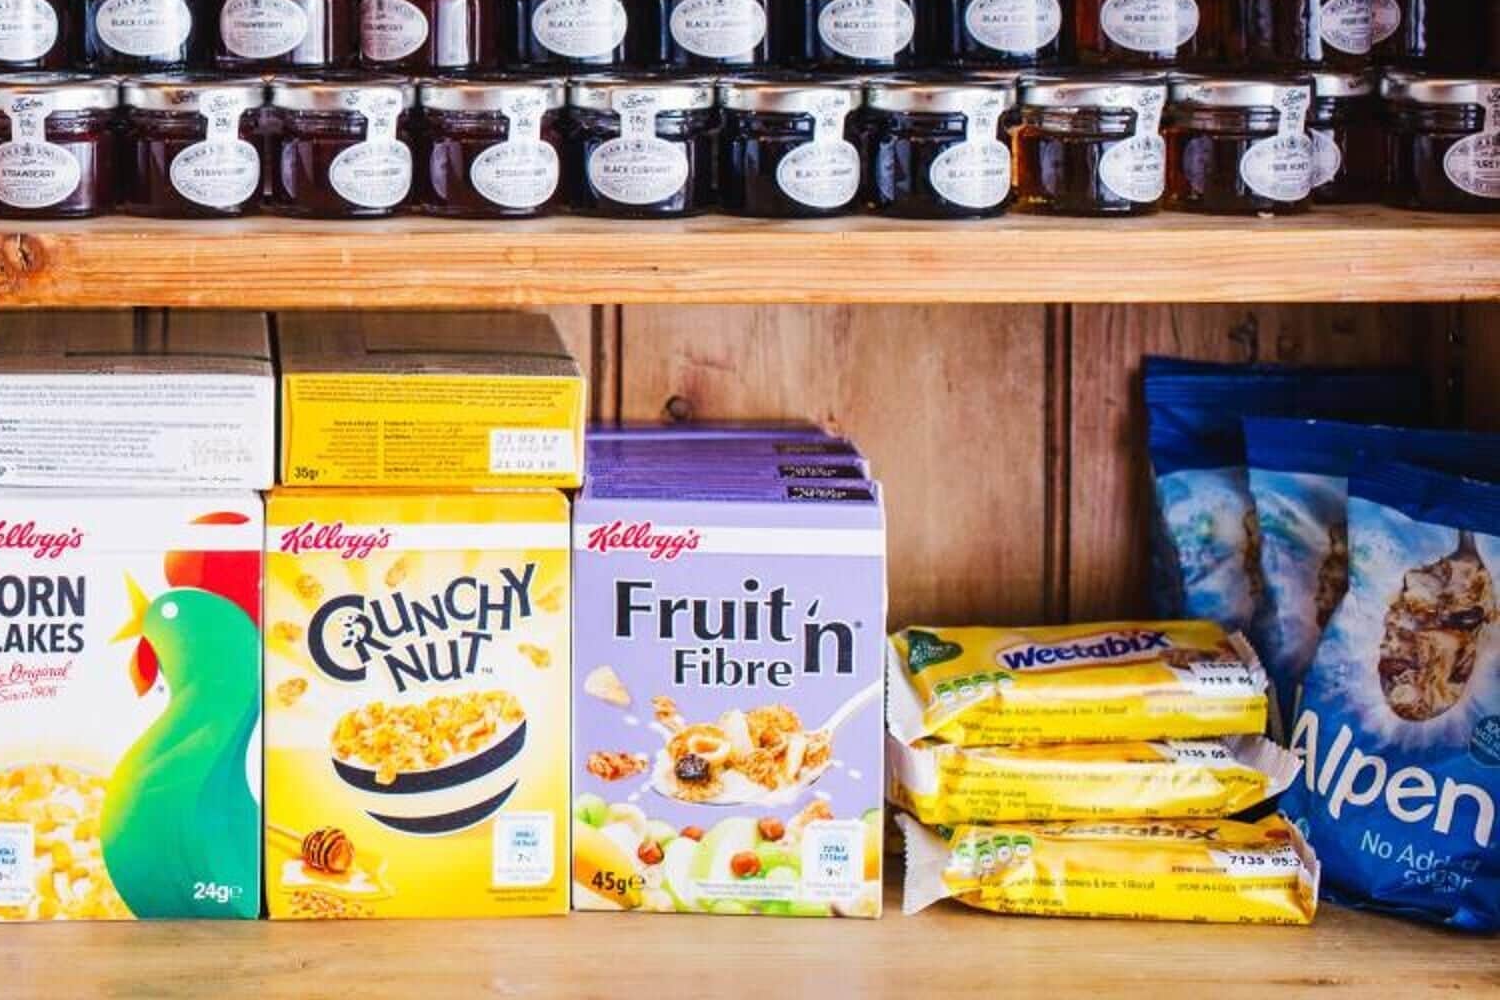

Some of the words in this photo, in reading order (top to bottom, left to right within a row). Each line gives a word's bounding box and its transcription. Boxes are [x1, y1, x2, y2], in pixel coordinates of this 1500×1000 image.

[603, 164, 628, 175] BLACK
[280, 521, 393, 560] Kellogg's
[587, 520, 701, 560] Kellogg's
[307, 562, 536, 683] CRUNCHY
[615, 578, 793, 643] Fruit
[383, 631, 493, 694] NUT
[674, 646, 793, 687] Fibre
[1002, 630, 1172, 671] Weetabix
[7, 661, 72, 686] Original
[1289, 708, 1496, 850] Alpen
[1360, 829, 1394, 860] No
[193, 882, 230, 903] 24g
[591, 870, 627, 895] 45g
